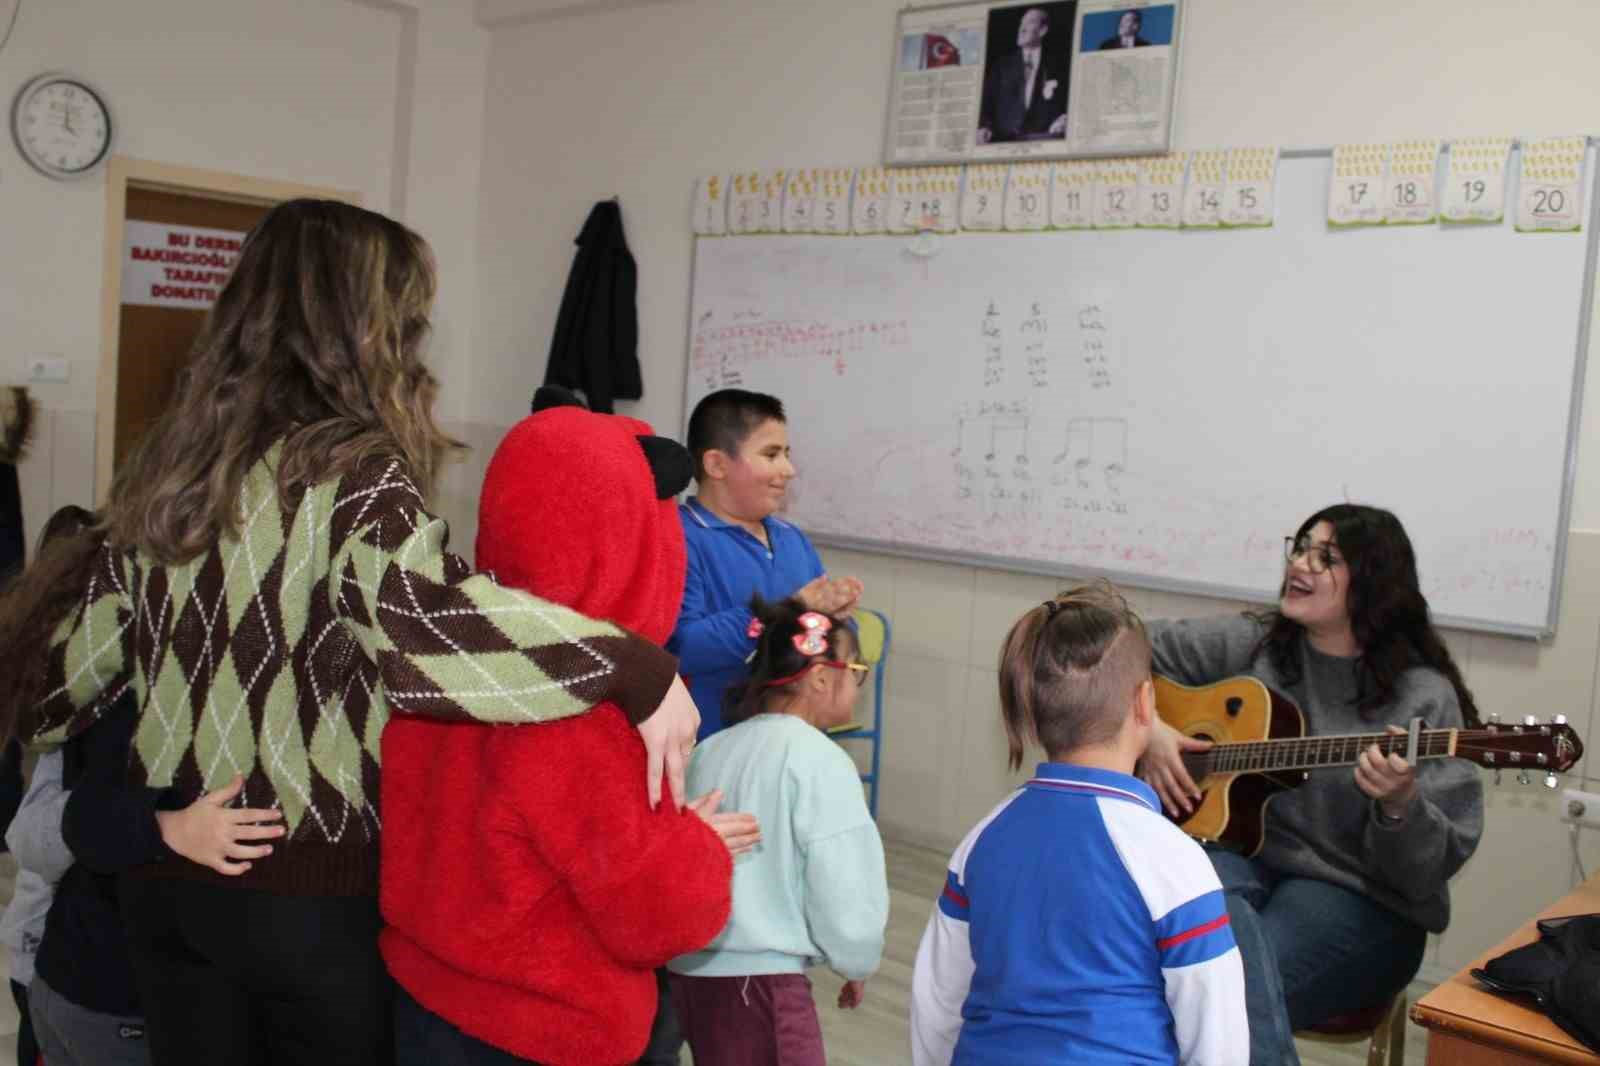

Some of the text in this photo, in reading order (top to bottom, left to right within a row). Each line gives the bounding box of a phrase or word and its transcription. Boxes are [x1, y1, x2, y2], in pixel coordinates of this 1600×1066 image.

[1066, 191, 1080, 211] 11
[1106, 190, 1126, 211] 12
[1200, 188, 1219, 211] 14
[1237, 186, 1257, 209] 15
[1348, 182, 1369, 205] 17
[1394, 182, 1417, 205] 18
[1462, 179, 1487, 203] 19
[1532, 189, 1565, 214] 20
[825, 201, 835, 221] 5
[866, 201, 878, 219] 6
[903, 200, 912, 218] 7
[977, 194, 988, 215] 9
[1018, 193, 1037, 213] 10
[1152, 191, 1170, 213] 13
[168, 232, 191, 247] BU
[151, 284, 223, 301] DONATIL
